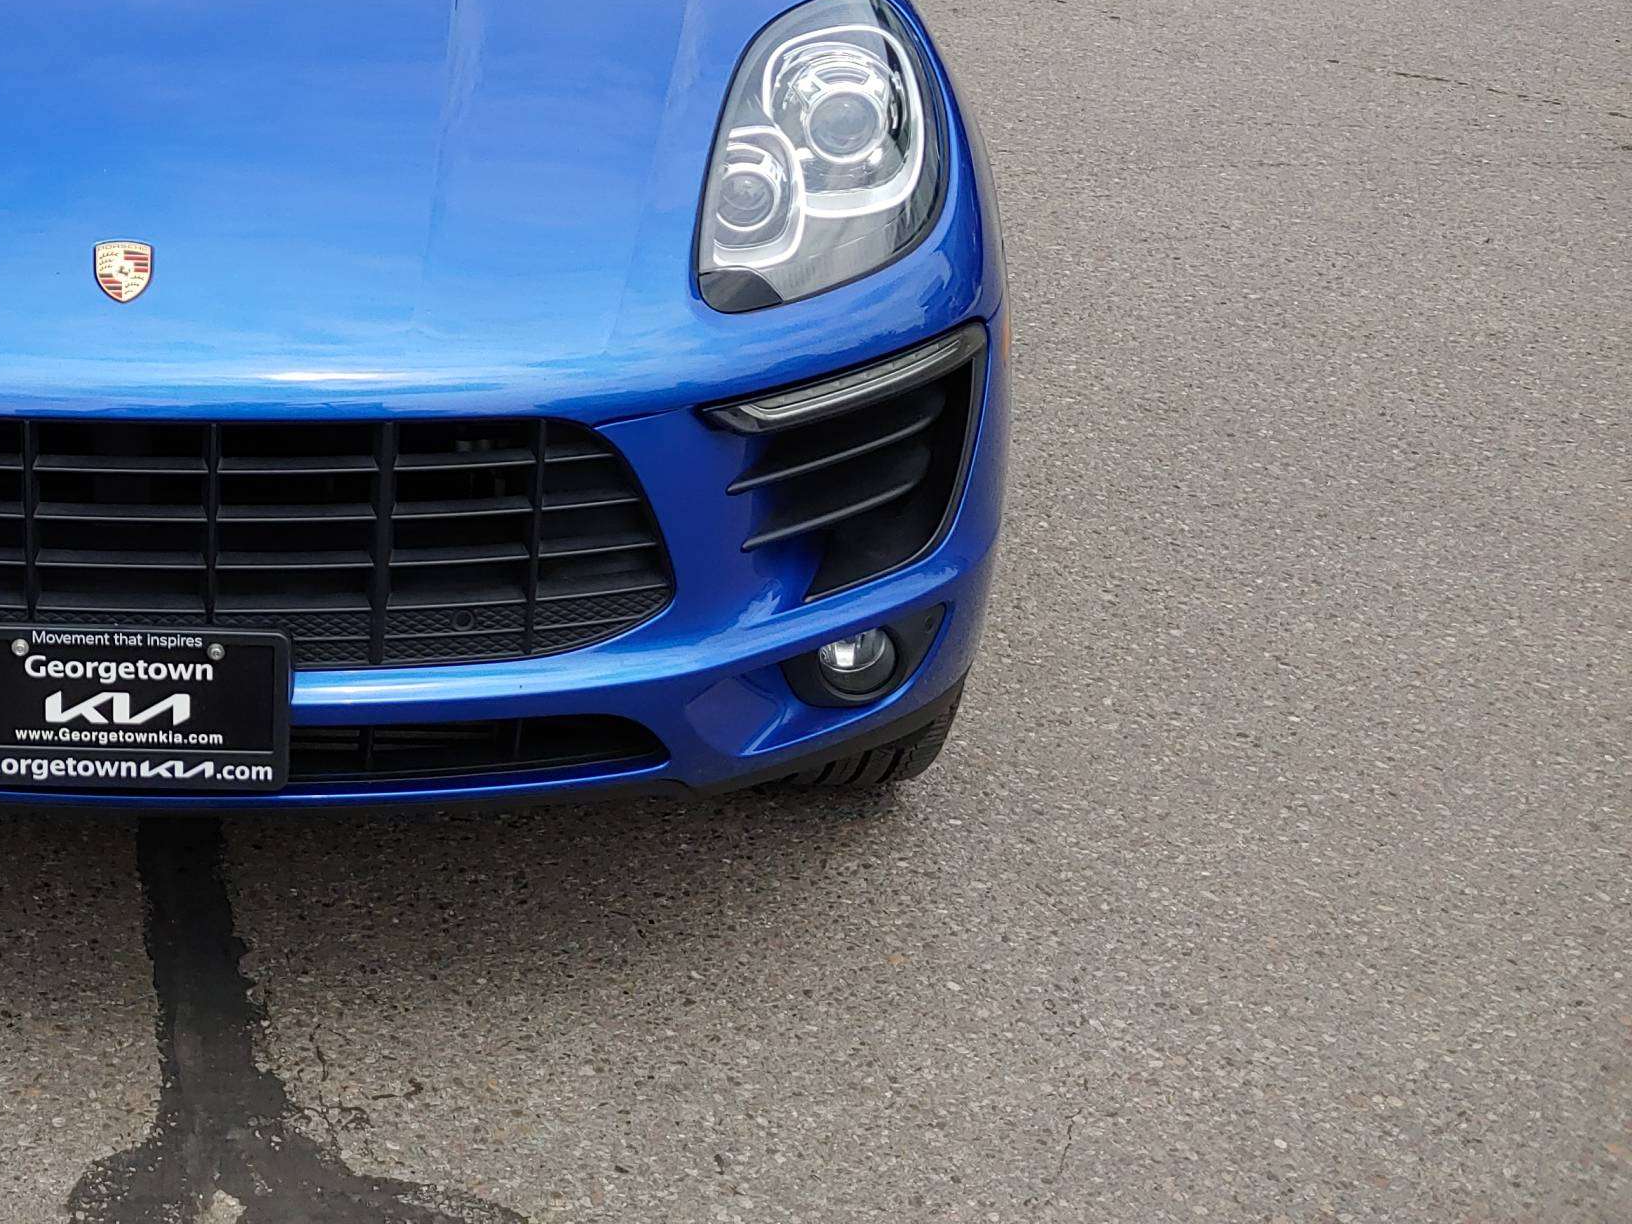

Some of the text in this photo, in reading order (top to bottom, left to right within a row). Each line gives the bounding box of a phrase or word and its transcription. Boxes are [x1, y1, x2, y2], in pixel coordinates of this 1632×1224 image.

[31, 630, 203, 650] Movement that inspires
[24, 655, 214, 684] Georgetown
[45, 690, 191, 726] KIA
[15, 727, 223, 745] www.Georgetownkia.com
